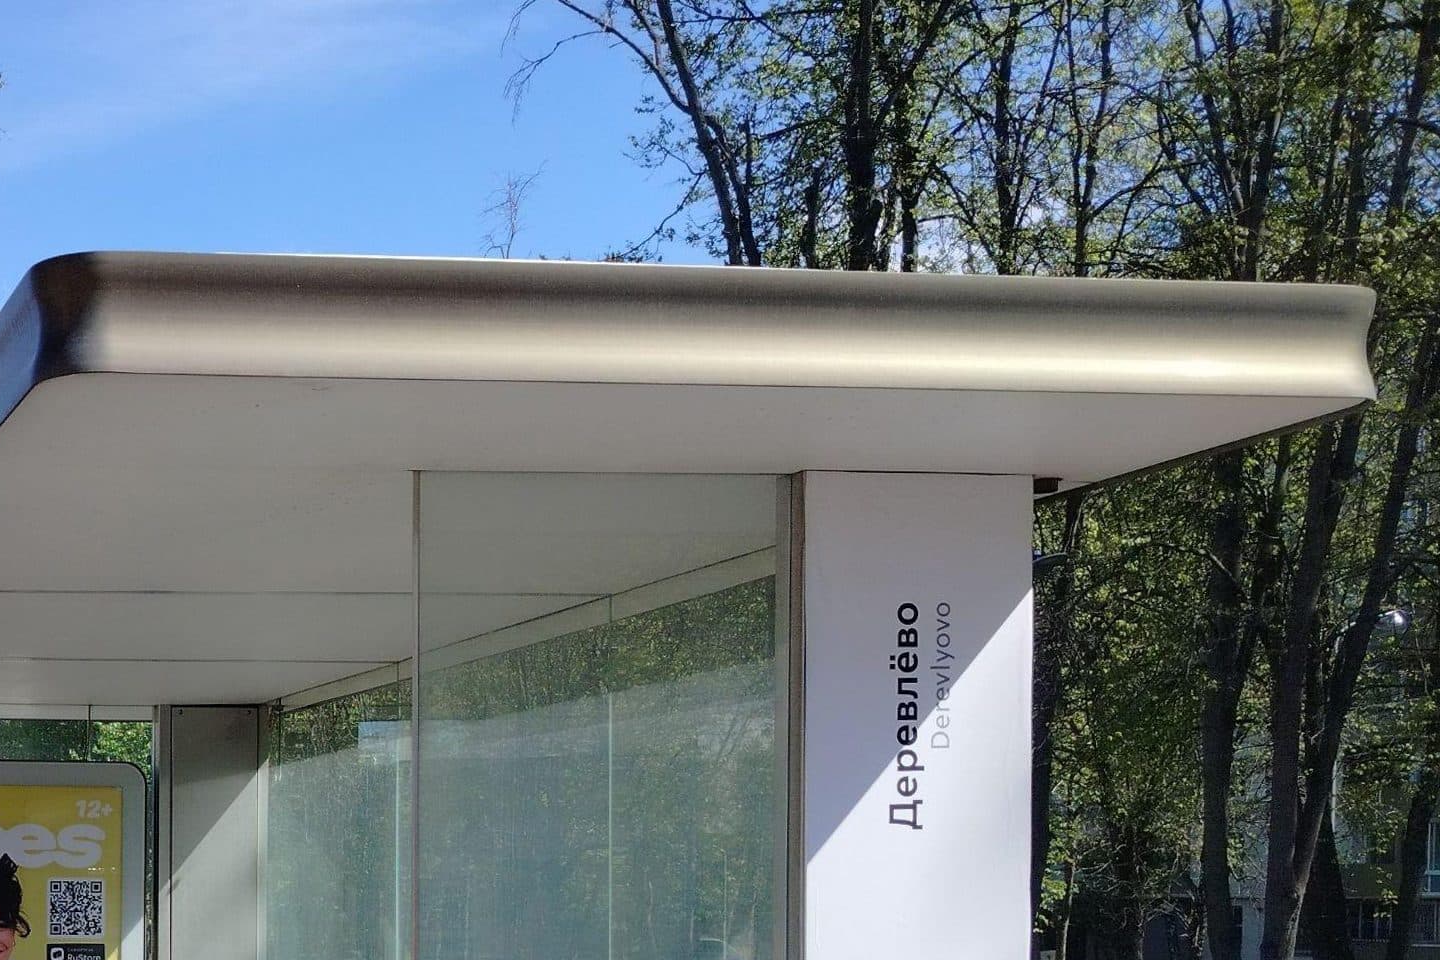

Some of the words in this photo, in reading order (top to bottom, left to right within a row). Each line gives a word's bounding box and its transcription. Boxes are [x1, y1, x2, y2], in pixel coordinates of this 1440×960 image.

[888, 602, 925, 830] Деревлёво
[929, 602, 956, 749] Derevlyovo
[75, 799, 113, 819] 12+
